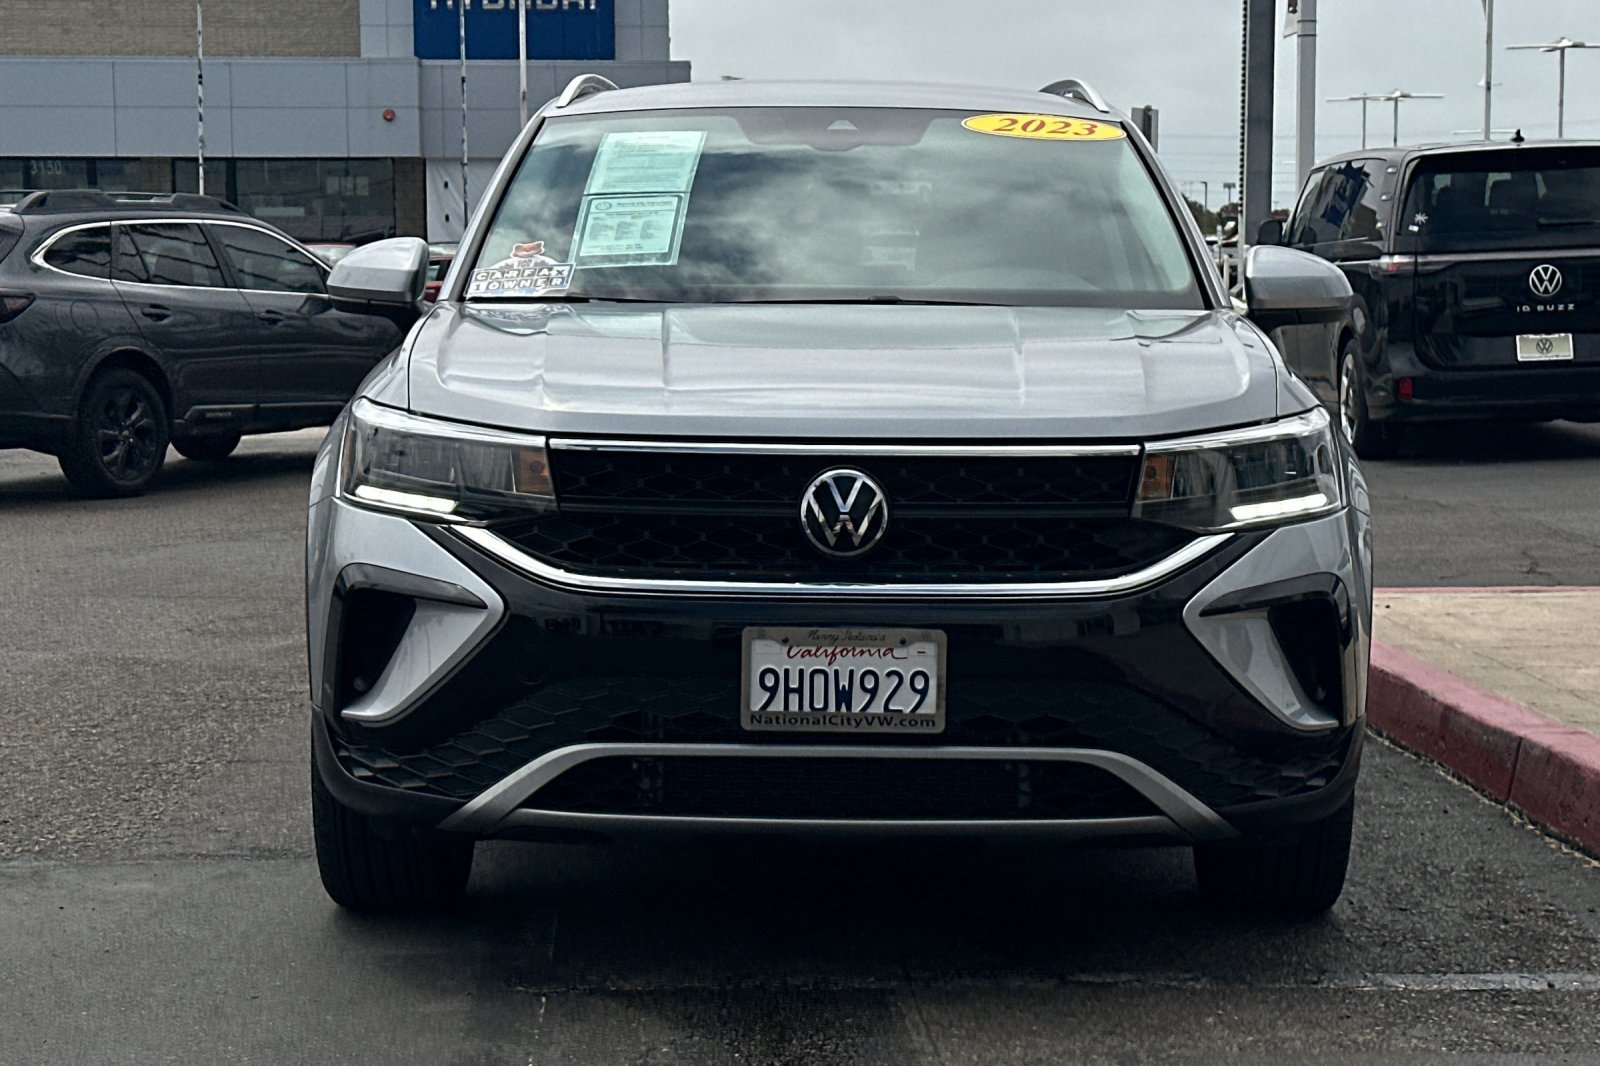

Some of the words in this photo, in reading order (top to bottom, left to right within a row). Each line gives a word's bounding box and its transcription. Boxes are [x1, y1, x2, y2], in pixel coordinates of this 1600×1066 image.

[993, 118, 1099, 136] 2023
[476, 266, 566, 280] CARFAX
[488, 278, 563, 290] OWNER
[1537, 303, 1575, 311] BUZZ
[786, 645, 908, 667] California
[750, 713, 936, 729] NationalCityVW.com
